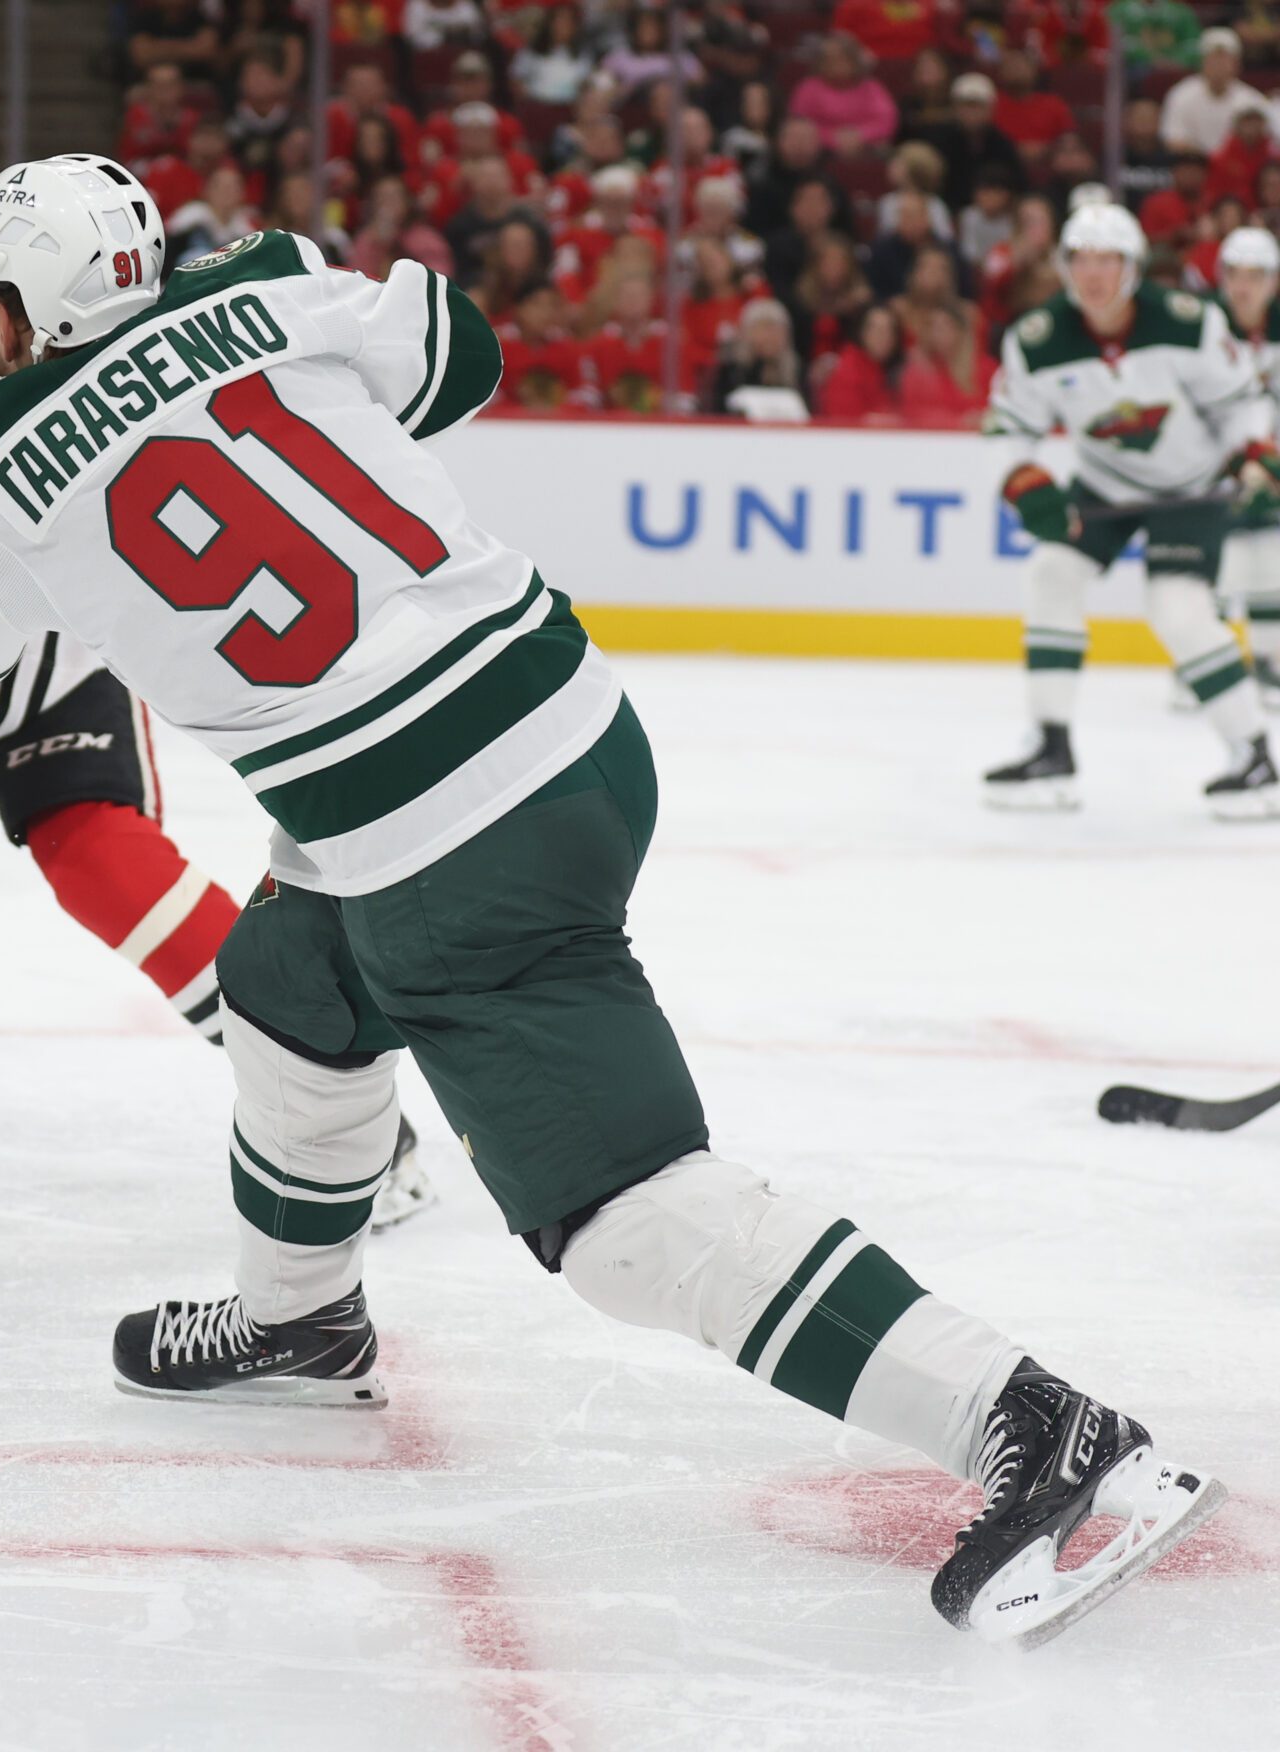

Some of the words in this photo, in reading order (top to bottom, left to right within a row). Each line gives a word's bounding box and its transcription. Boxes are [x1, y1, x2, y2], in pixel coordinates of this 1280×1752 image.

[113, 248, 142, 288] 91
[105, 371, 451, 688] 91
[627, 483, 1146, 559] UNIT
[7, 732, 113, 768] CCM
[235, 1349, 294, 1373] CCM
[1075, 1399, 1104, 1467] CCM
[996, 1593, 1039, 1611] CCM
